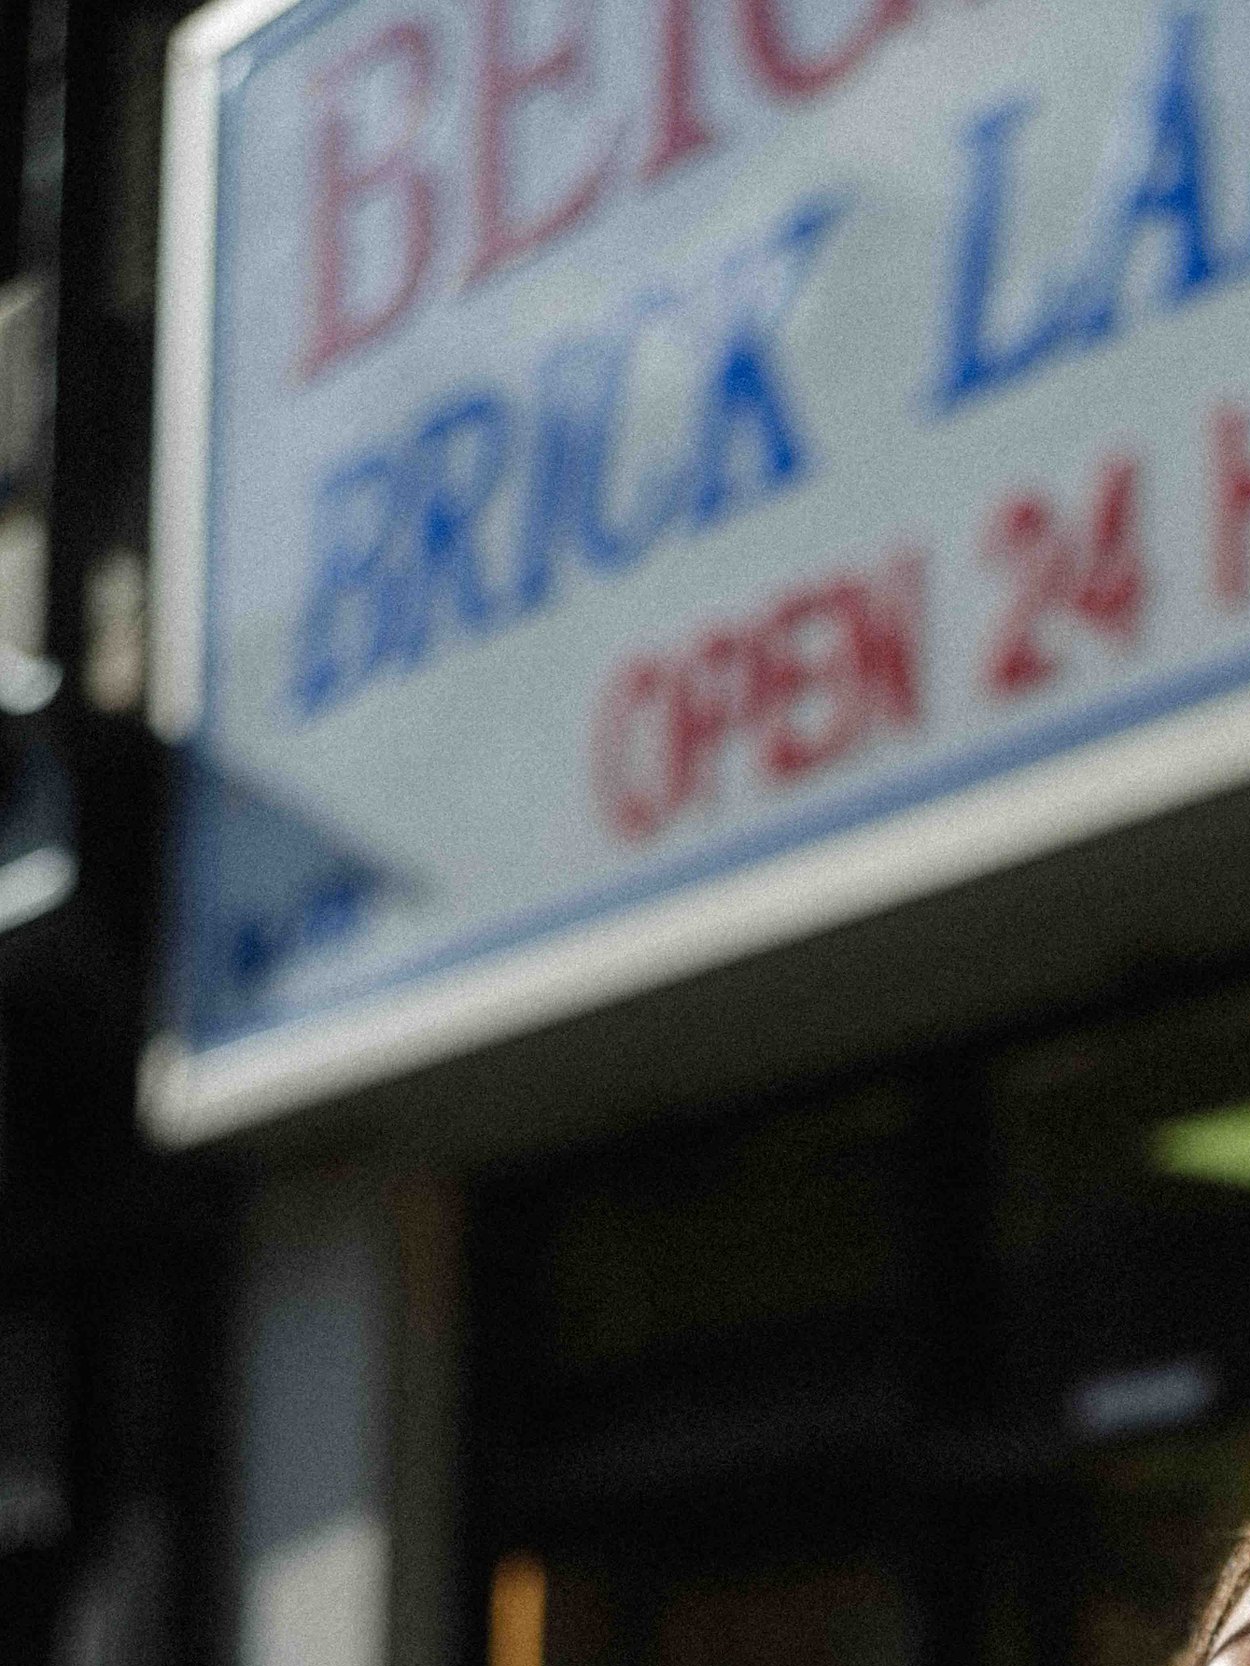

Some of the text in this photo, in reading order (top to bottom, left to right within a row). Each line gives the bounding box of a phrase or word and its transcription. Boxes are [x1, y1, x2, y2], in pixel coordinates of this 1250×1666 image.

[288, 182, 854, 722] BRICK
[600, 525, 932, 846] OPEN
[980, 450, 1148, 698] 24
